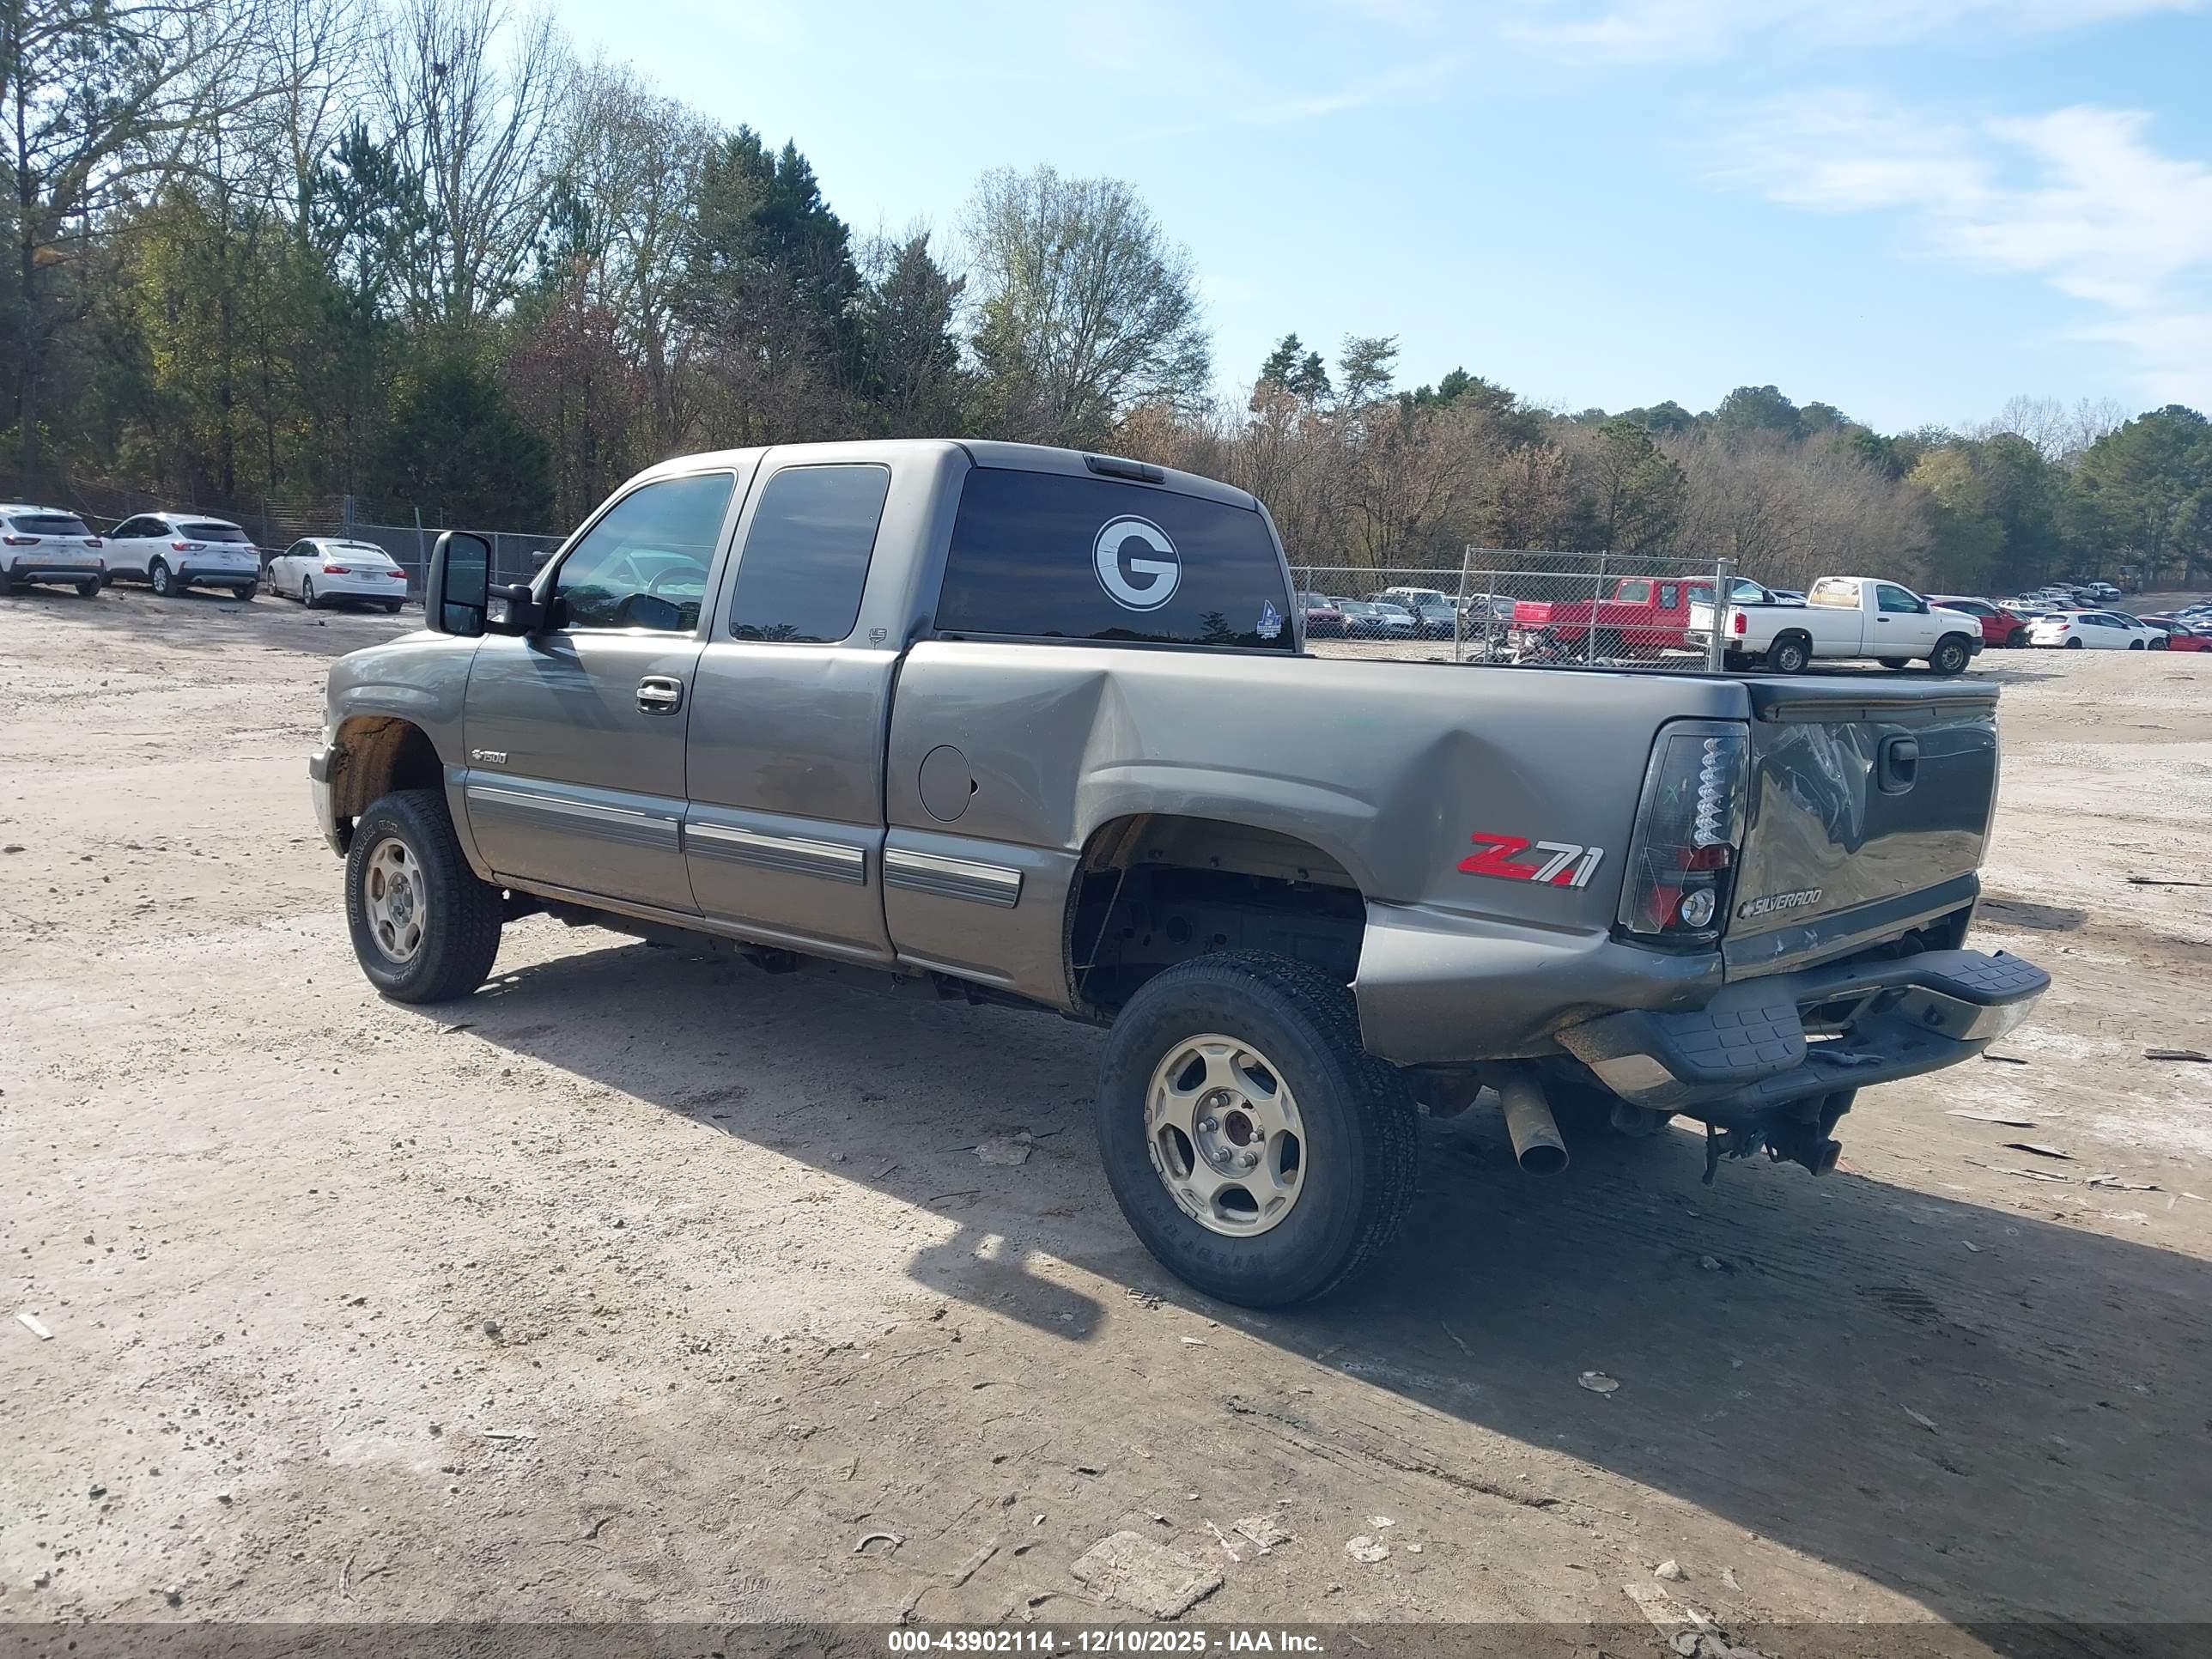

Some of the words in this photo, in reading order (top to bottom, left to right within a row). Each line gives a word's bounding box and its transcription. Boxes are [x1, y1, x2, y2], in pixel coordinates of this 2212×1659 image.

[1097, 521, 1178, 605] G
[483, 750, 507, 763] 1500
[1456, 831, 1605, 888] Z71
[1753, 888, 1823, 915] SILVERADO
